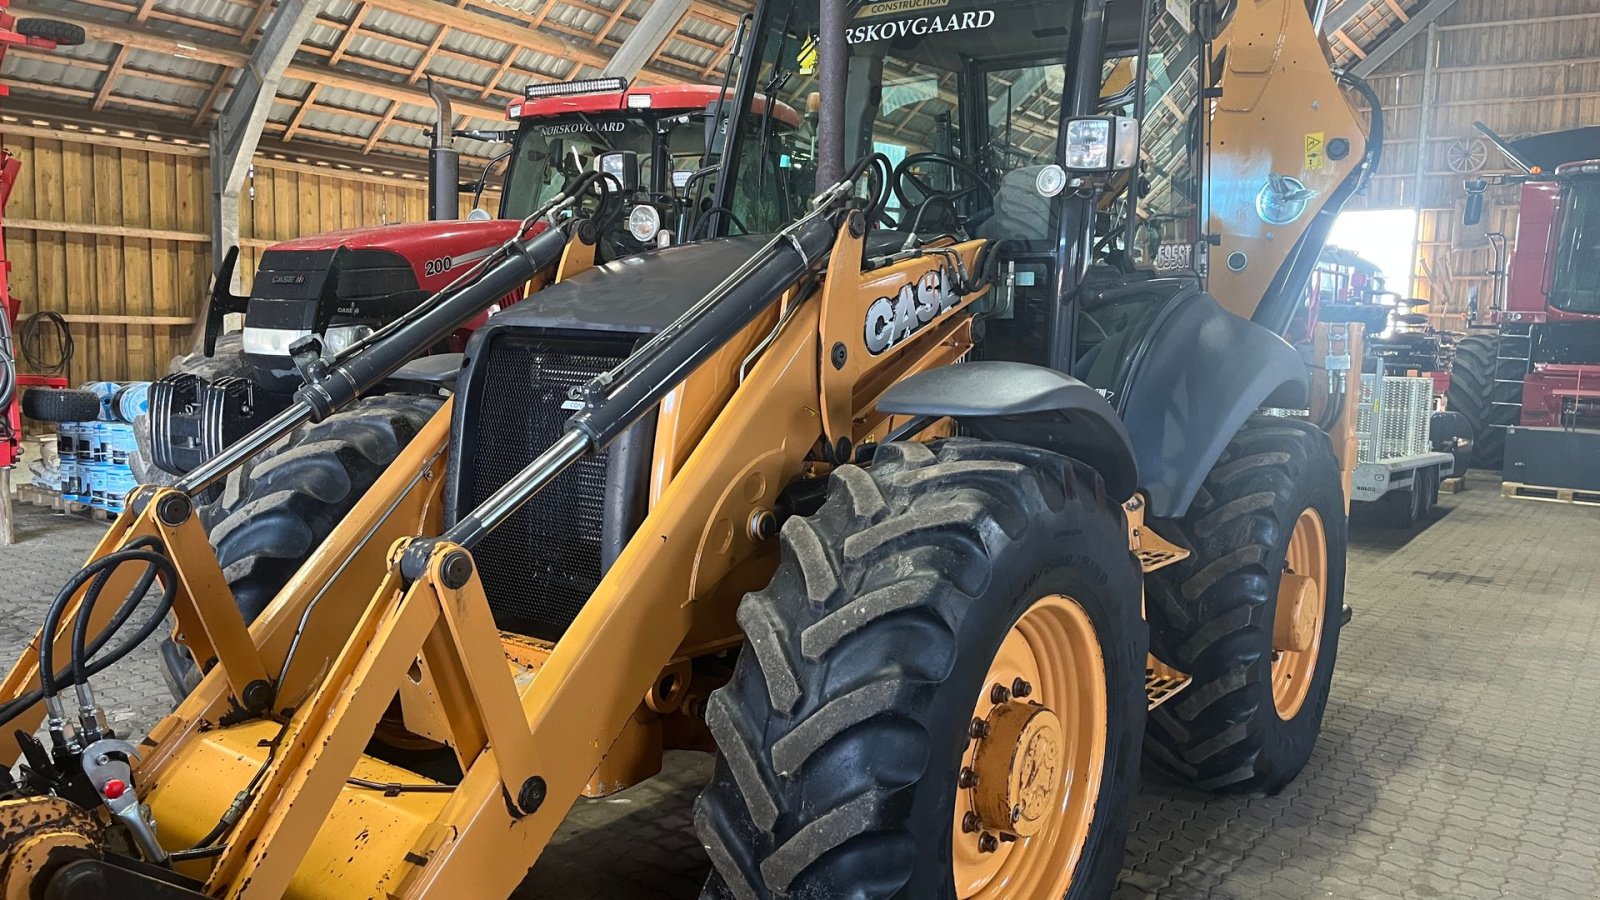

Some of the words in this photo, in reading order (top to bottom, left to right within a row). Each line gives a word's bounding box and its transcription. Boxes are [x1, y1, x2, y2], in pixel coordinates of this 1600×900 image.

[813, 10, 995, 45] RSKOVGAARD
[424, 255, 452, 277] 200
[1157, 243, 1192, 271] 695ST
[272, 275, 295, 283] CASE
